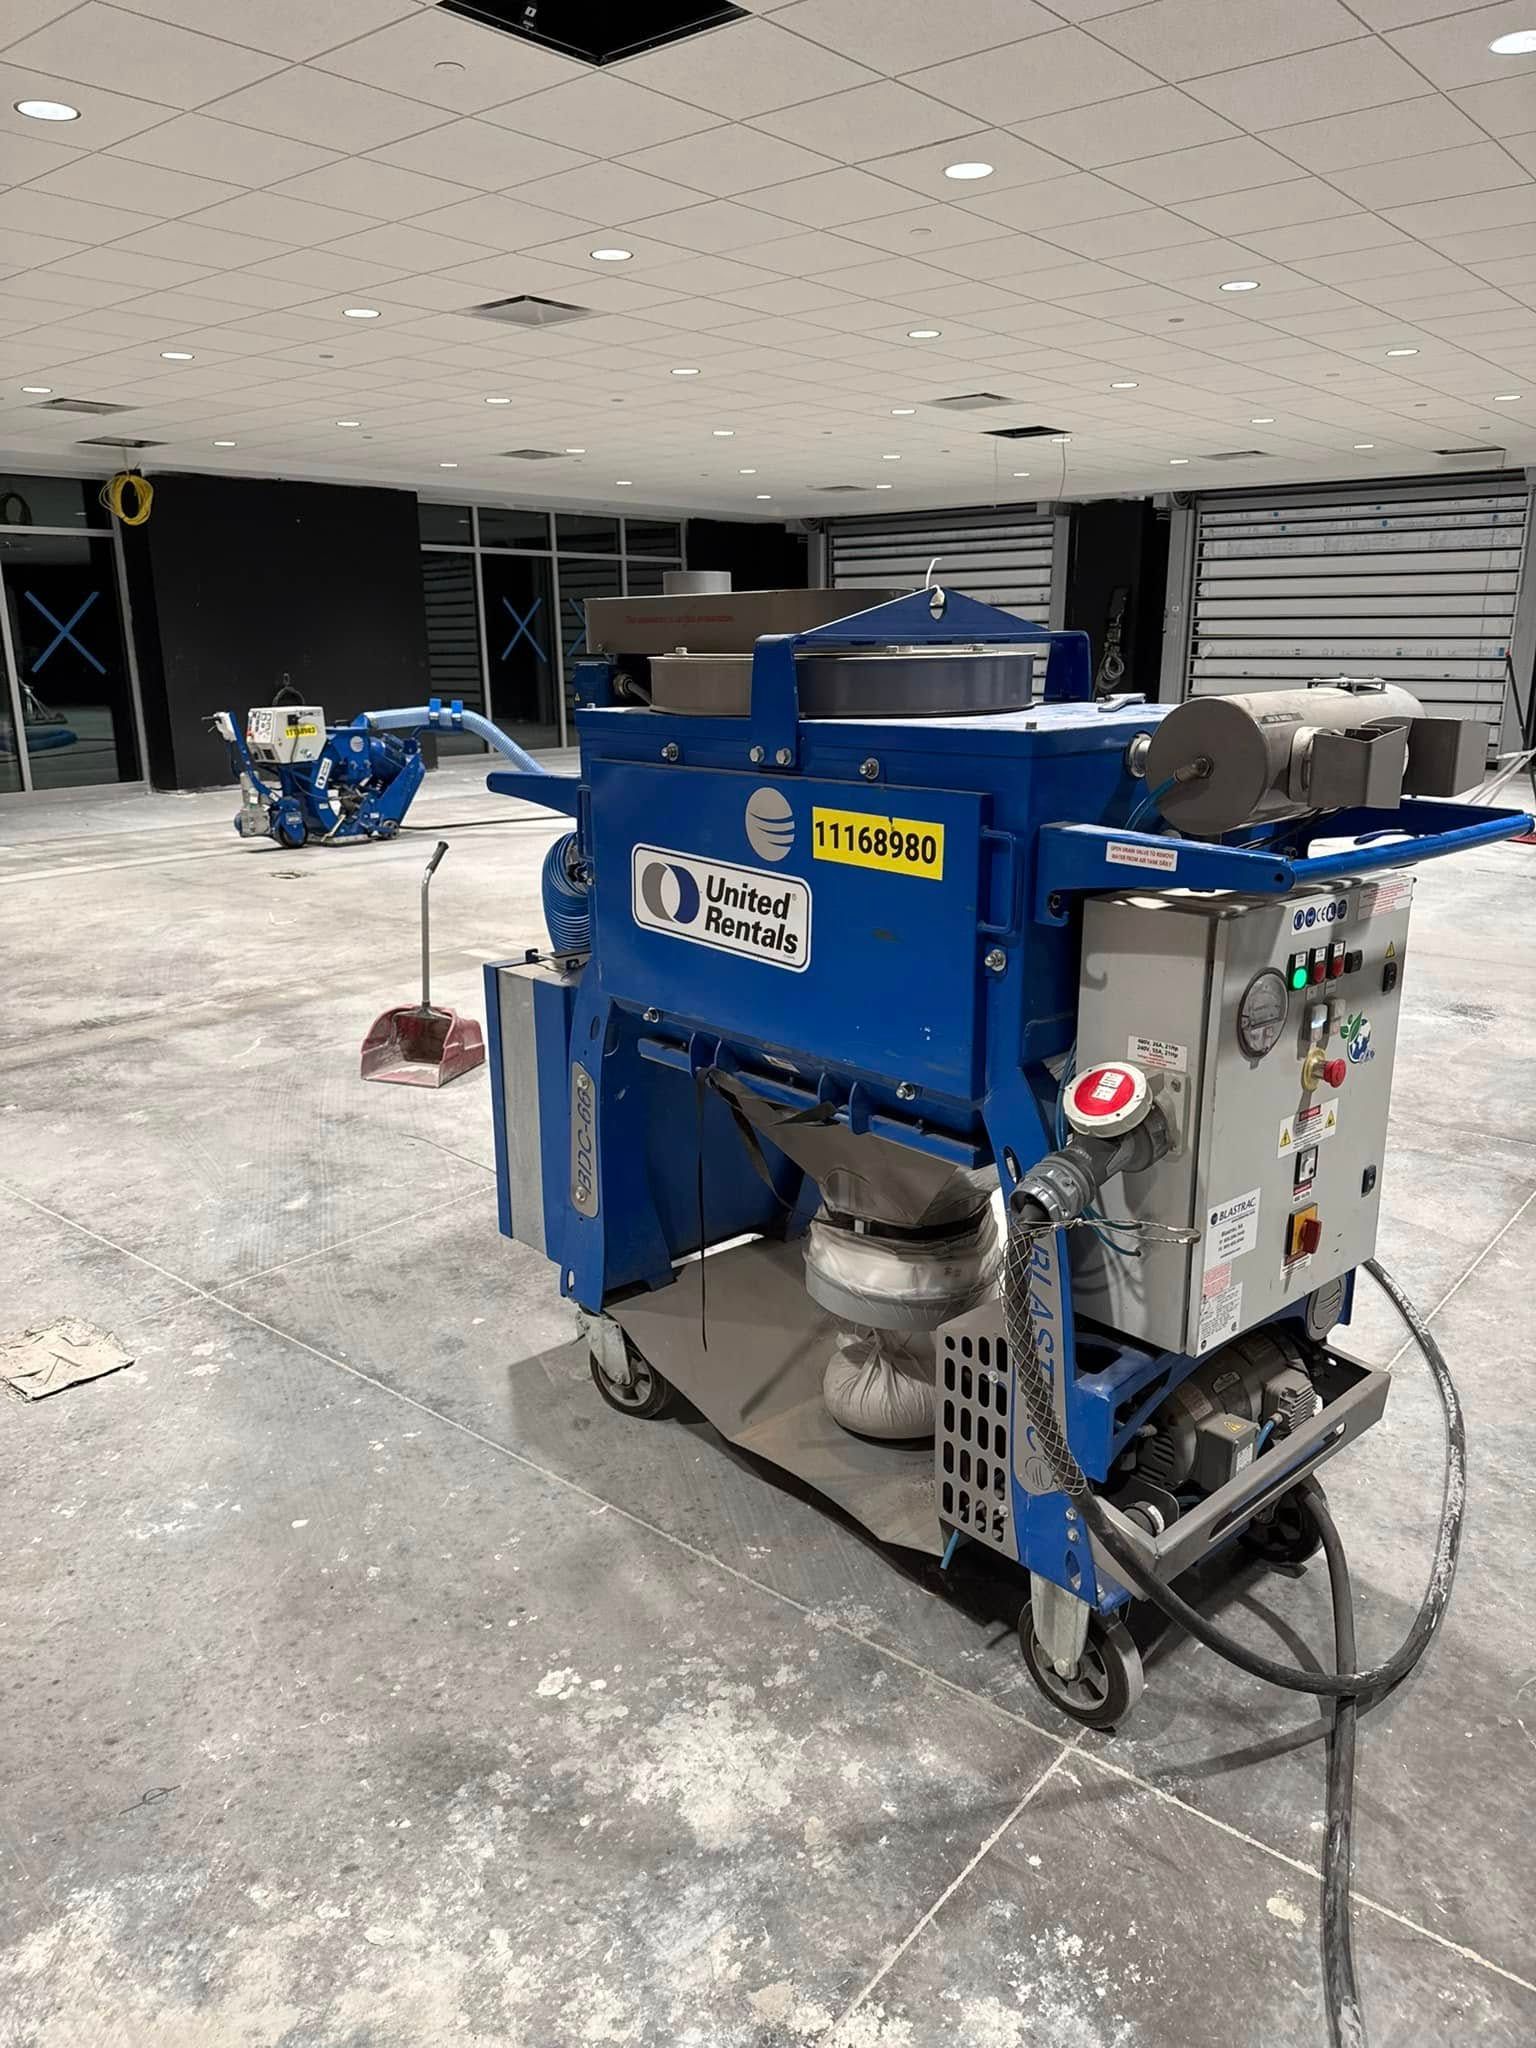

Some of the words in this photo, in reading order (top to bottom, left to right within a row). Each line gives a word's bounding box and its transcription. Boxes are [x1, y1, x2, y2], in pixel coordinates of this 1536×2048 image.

[815, 821, 937, 864] 11168980
[1157, 851, 1174, 859] REMOVE
[1159, 859, 1172, 867] DAILY
[705, 875, 792, 920] United
[704, 905, 798, 954] Rentals
[577, 1087, 592, 1194] BDC-66
[1219, 1196, 1256, 1221] BLASTRAC
